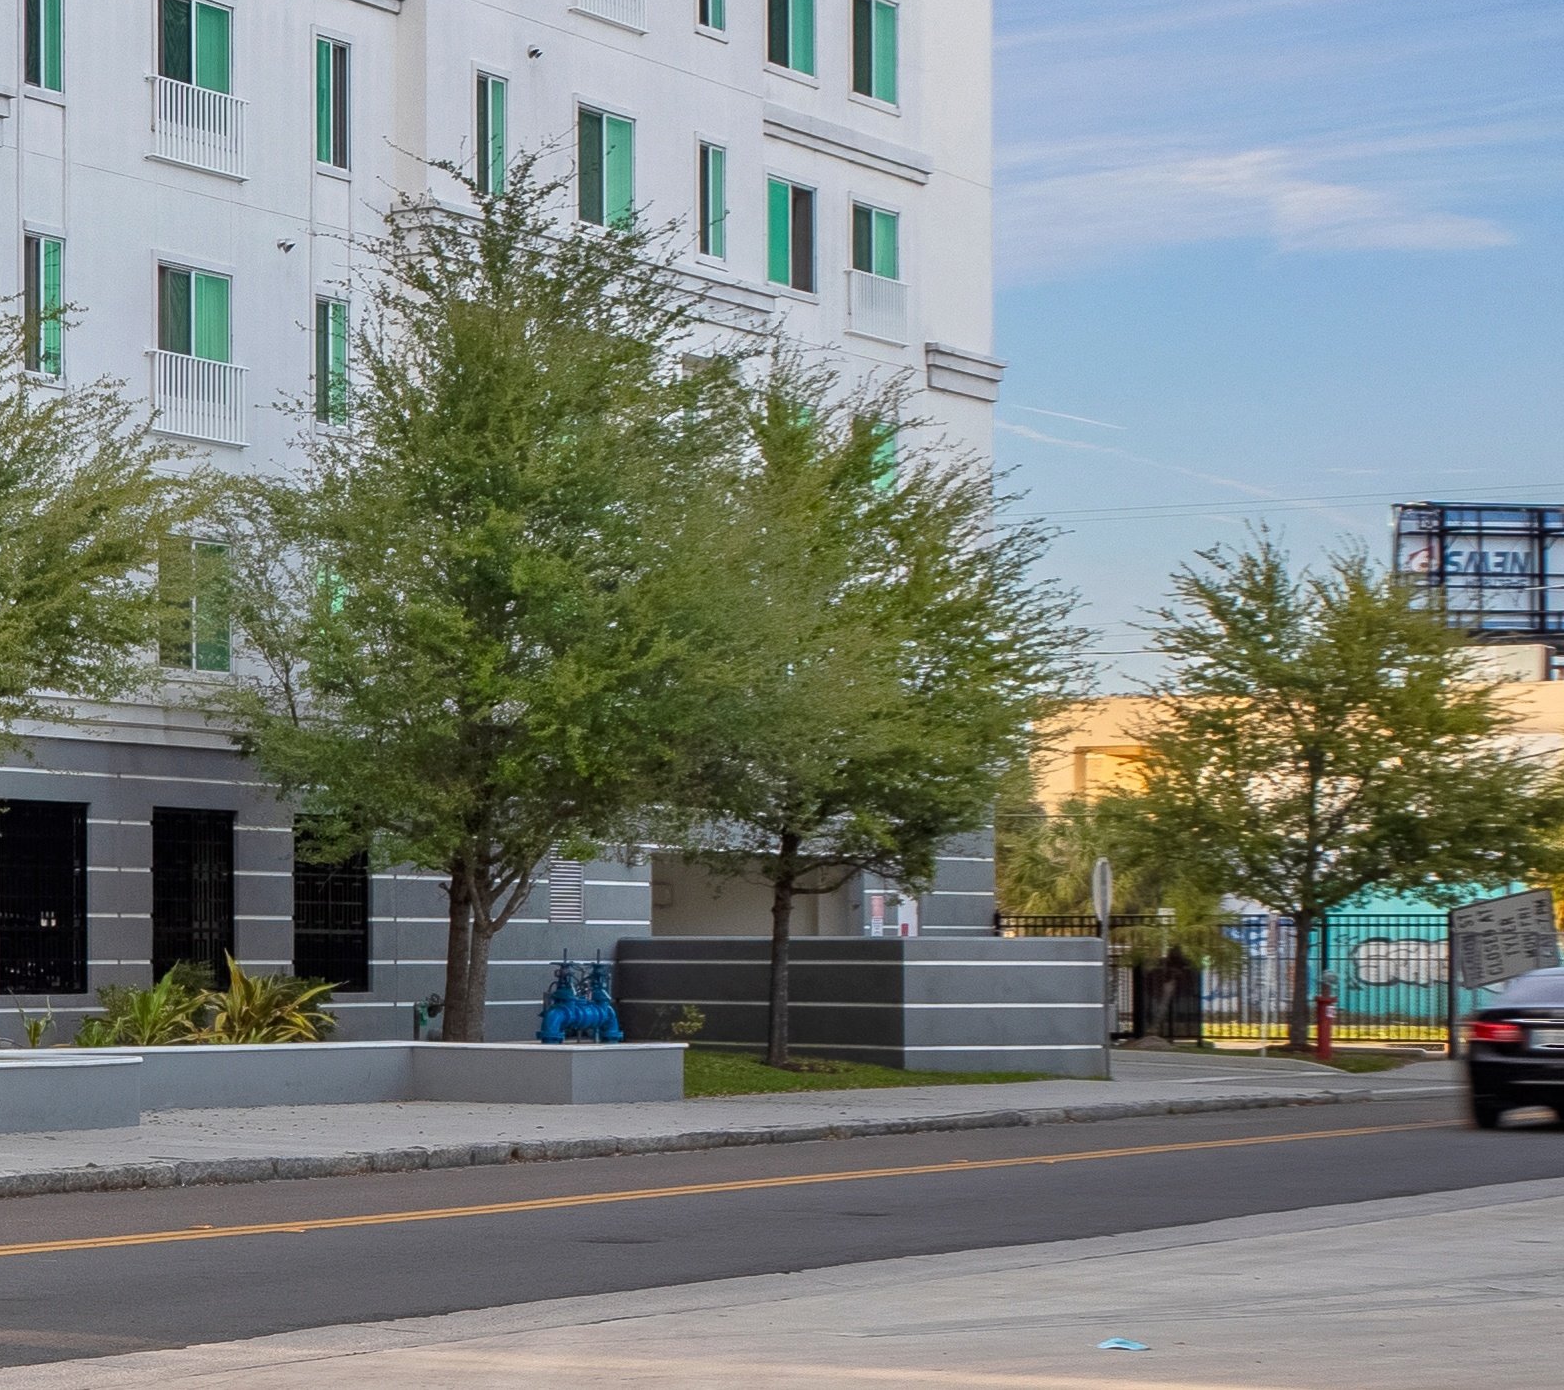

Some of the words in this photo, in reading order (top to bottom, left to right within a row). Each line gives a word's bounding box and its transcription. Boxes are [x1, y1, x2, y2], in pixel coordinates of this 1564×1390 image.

[1477, 909, 1494, 922] AT
[1483, 929, 1503, 975] CLOSED
[1499, 917, 1520, 956] TYLER
